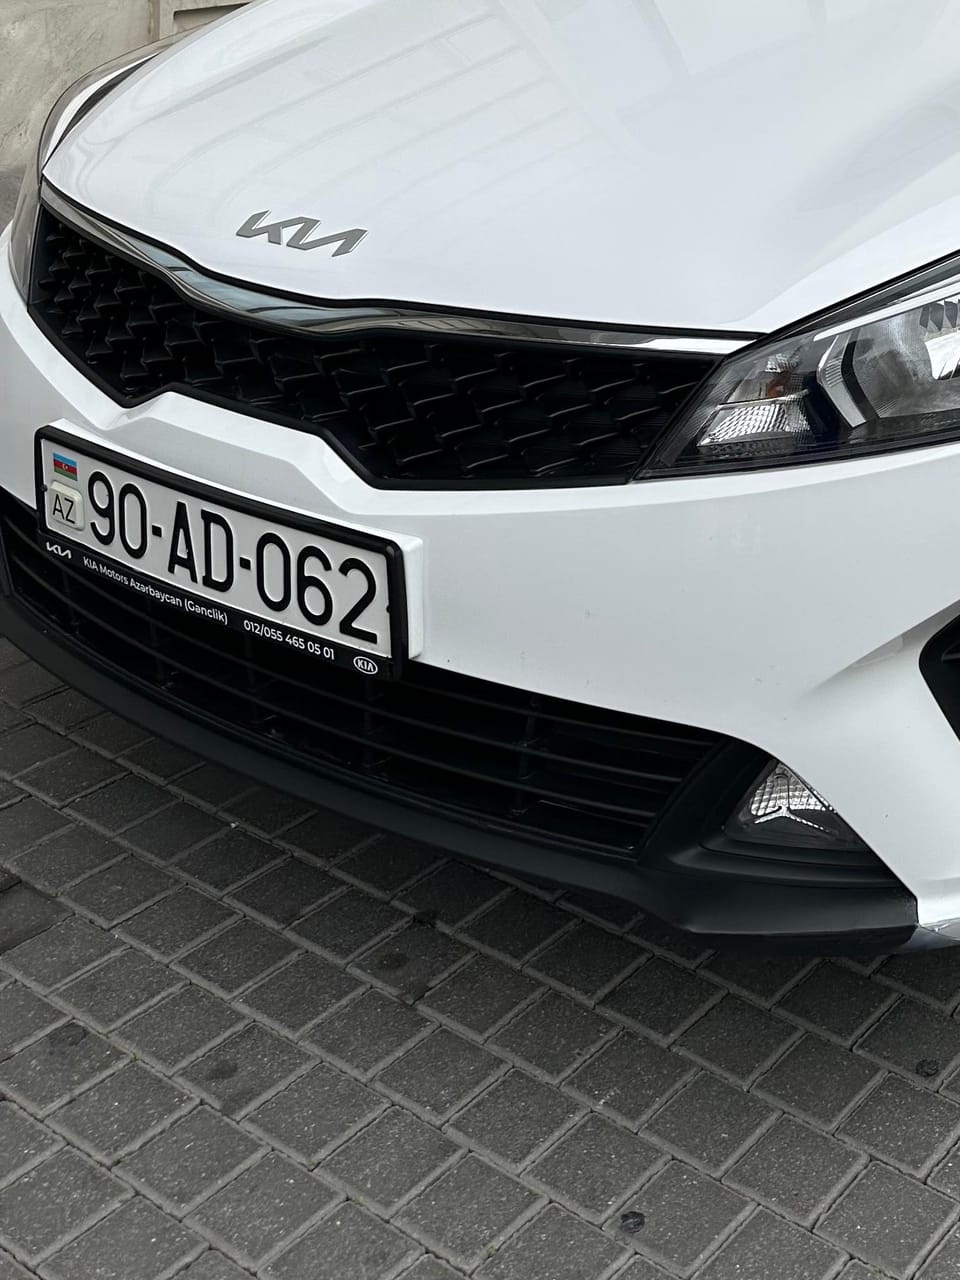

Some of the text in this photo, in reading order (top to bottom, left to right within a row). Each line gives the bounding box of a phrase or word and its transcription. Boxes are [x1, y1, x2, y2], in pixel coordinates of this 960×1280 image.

[52, 493, 76, 525] AZ
[83, 556, 99, 572] KIA
[99, 564, 129, 585] Motors
[87, 470, 378, 644] 90-AD-062
[243, 620, 336, 660] 012/055 465 05 01
[357, 658, 374, 673] KIA
